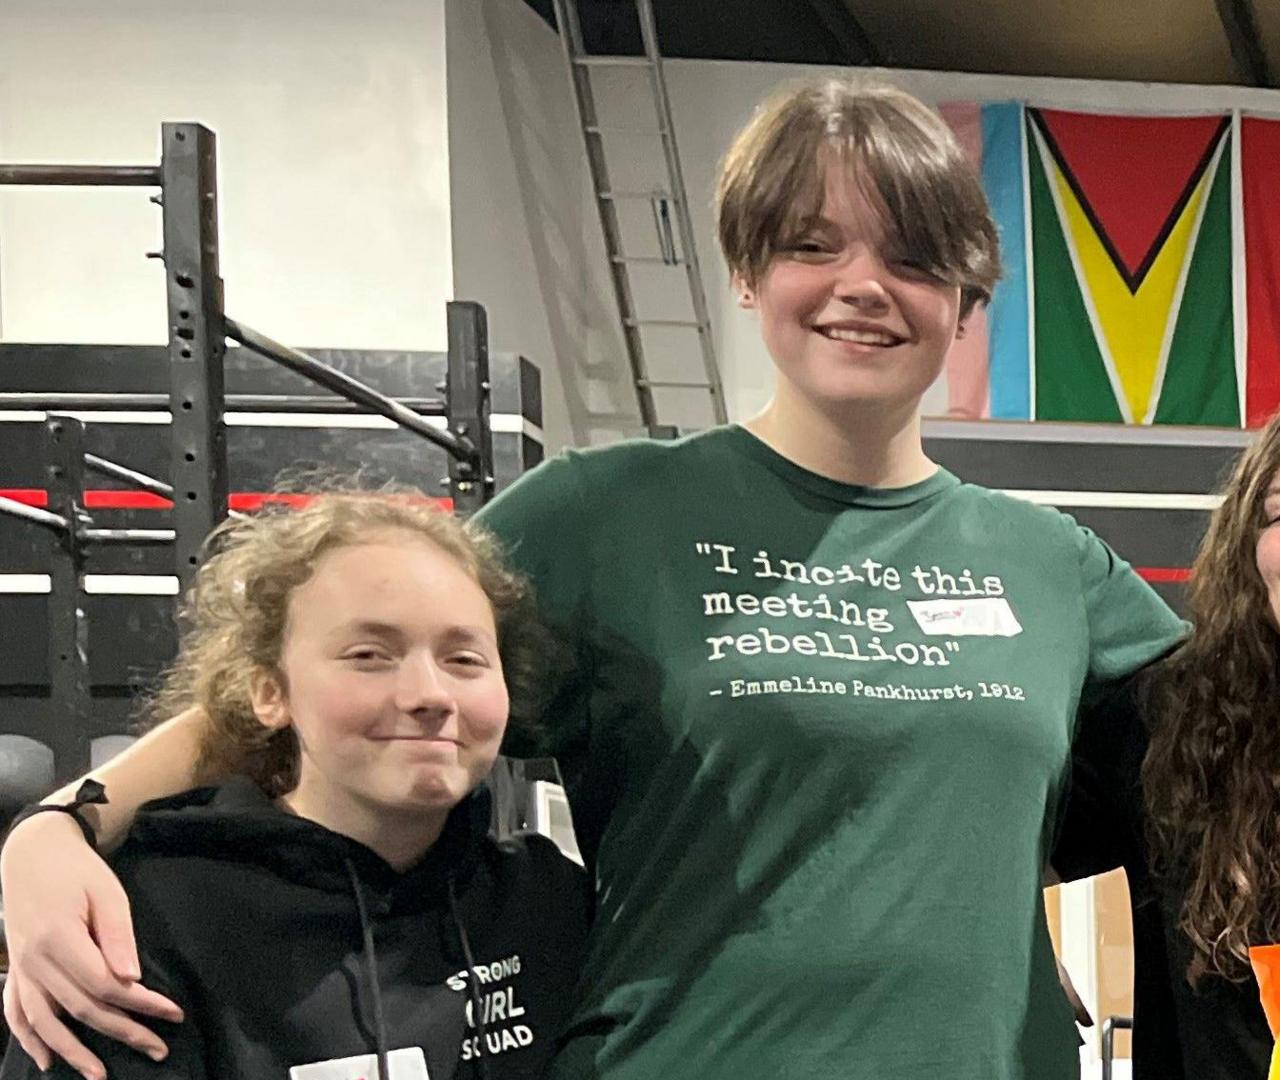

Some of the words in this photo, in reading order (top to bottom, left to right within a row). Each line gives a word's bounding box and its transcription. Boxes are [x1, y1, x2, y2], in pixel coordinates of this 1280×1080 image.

[753, 550, 901, 591] incite
[911, 565, 1005, 597] this
[702, 592, 895, 634] meeting
[705, 627, 960, 667] rebellion"
[730, 676, 847, 698] Emmeline
[852, 679, 974, 701] Pankhurst,
[446, 954, 521, 991] SRONG
